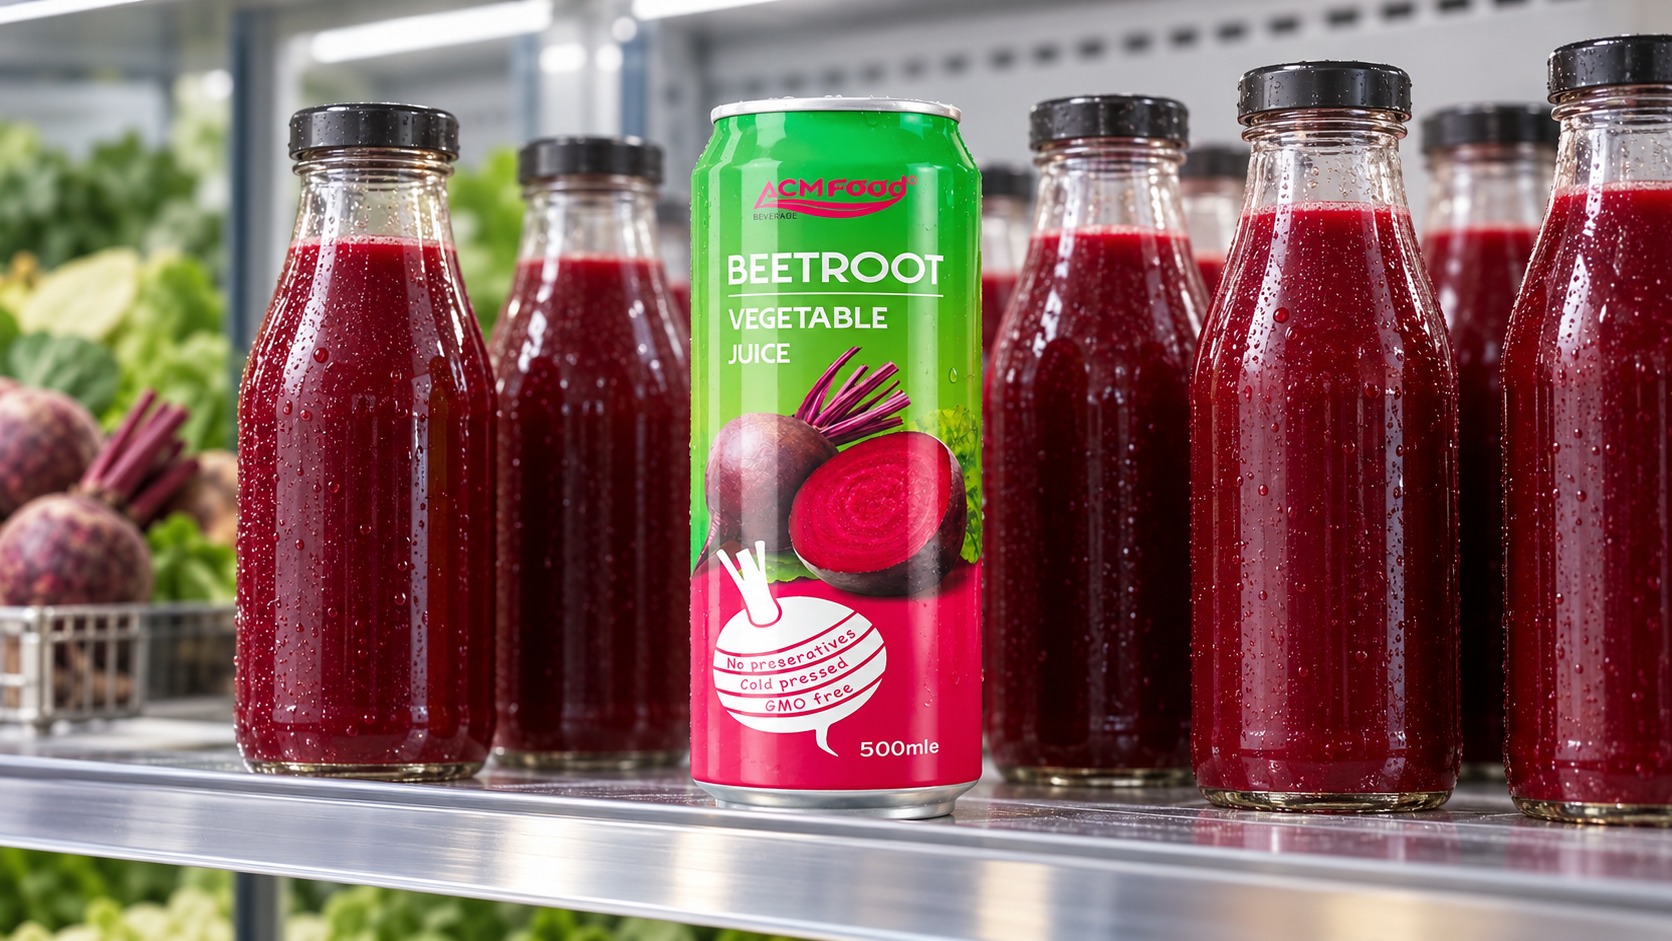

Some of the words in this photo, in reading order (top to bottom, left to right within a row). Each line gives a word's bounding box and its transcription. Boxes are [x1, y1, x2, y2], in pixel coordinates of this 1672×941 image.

[728, 251, 944, 285] BEETROOT
[728, 306, 888, 330] VEGETABLE
[728, 343, 791, 365] JUICE
[727, 657, 744, 670] No
[751, 628, 856, 672] preseratives
[740, 678, 773, 690] Cold
[779, 656, 849, 691] pressed
[765, 699, 806, 712] GMO
[813, 684, 854, 705] free
[860, 738, 939, 757] 500mle
